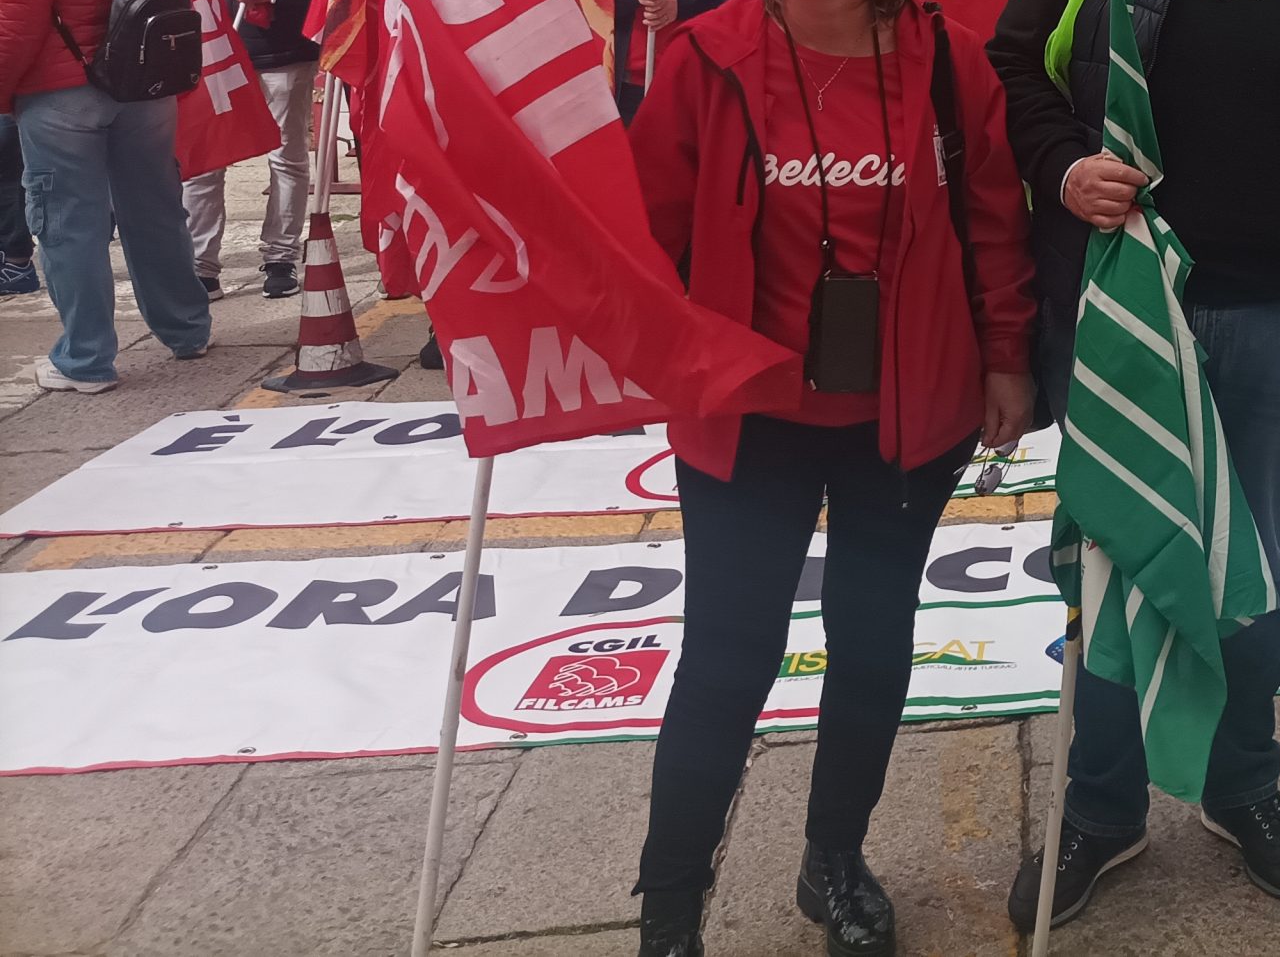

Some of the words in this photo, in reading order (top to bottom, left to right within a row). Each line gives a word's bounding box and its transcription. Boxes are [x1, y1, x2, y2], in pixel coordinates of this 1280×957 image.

[150, 414, 254, 456] È
[3, 570, 497, 642] L'ORA
[567, 634, 662, 654] CGIL
[517, 694, 643, 711] FILCAMS
